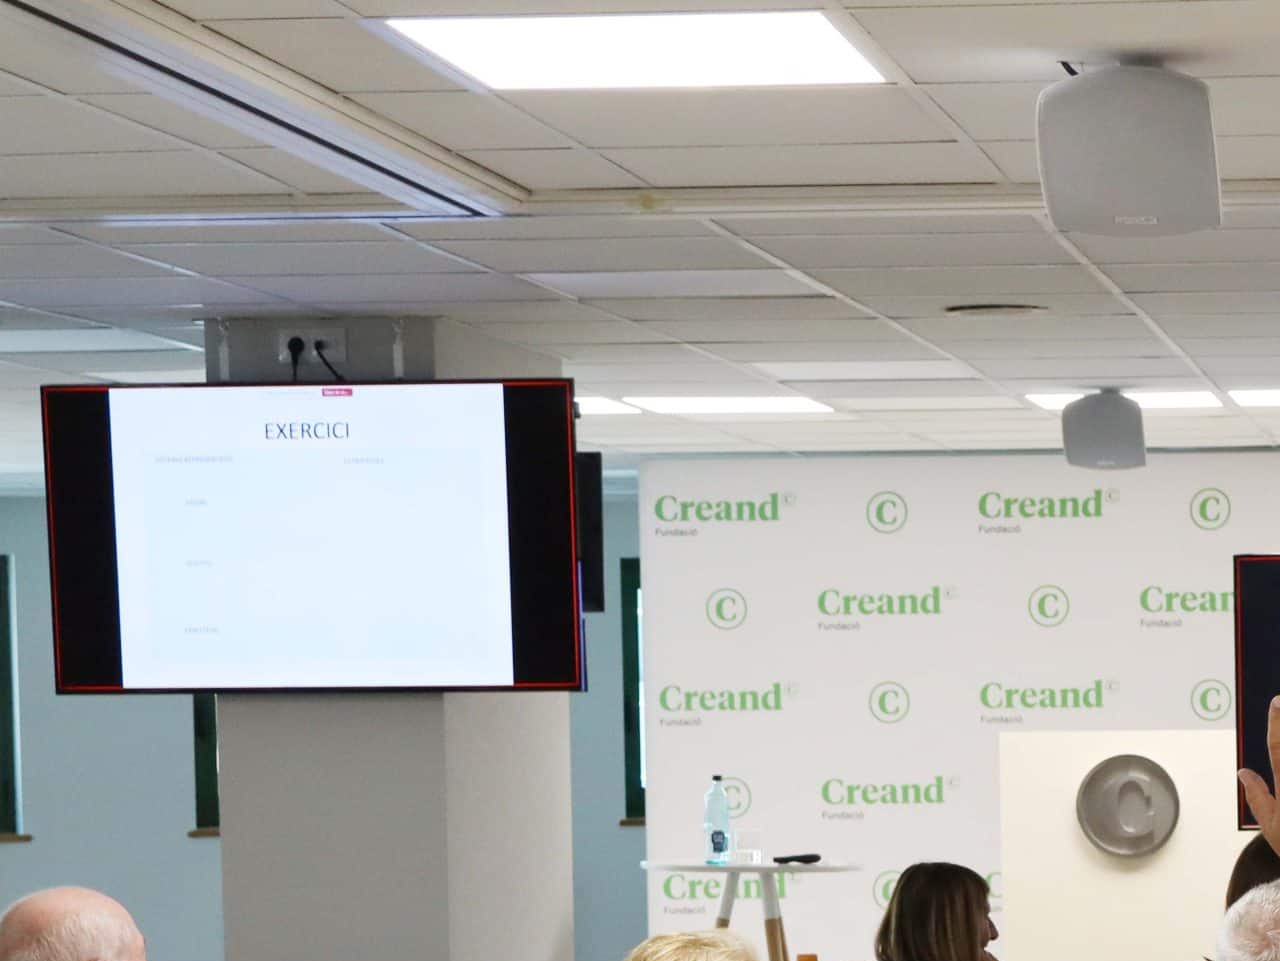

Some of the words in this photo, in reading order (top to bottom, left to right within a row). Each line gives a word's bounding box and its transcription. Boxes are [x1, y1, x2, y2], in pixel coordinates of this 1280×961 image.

[264, 421, 350, 440] EXERCICI
[654, 492, 780, 522] Creand
[977, 488, 1103, 519] Creand
[816, 585, 941, 616] Creand
[658, 682, 783, 712] Creand
[979, 680, 1103, 709] Creand
[820, 776, 944, 805] Creand
